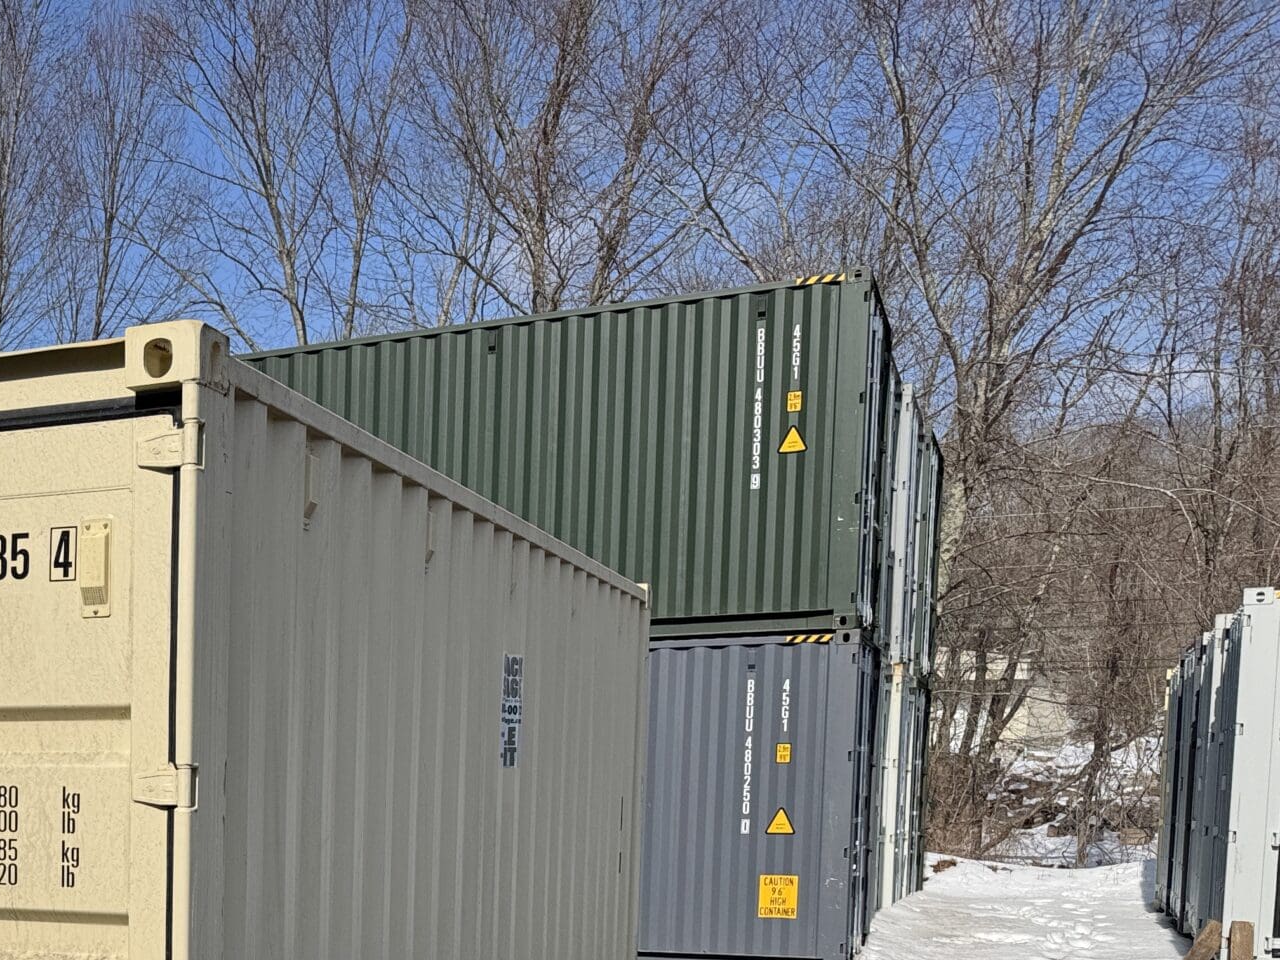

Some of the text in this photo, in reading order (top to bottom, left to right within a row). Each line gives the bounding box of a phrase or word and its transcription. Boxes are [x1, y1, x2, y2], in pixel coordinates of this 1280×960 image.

[757, 328, 766, 382] BBUU
[792, 324, 801, 379] 45G1
[752, 388, 762, 469] 480303
[53, 530, 73, 578] 4
[745, 679, 754, 732] BBUU
[782, 679, 790, 732] 45G1
[742, 736, 752, 815] 480250
[62, 786, 80, 814] kg
[62, 810, 76, 834] lb
[61, 840, 80, 868] kg
[61, 865, 75, 888] lb
[763, 877, 794, 887] CAUTION
[759, 906, 796, 917] CONTAINER
[770, 897, 787, 906] HIGH
